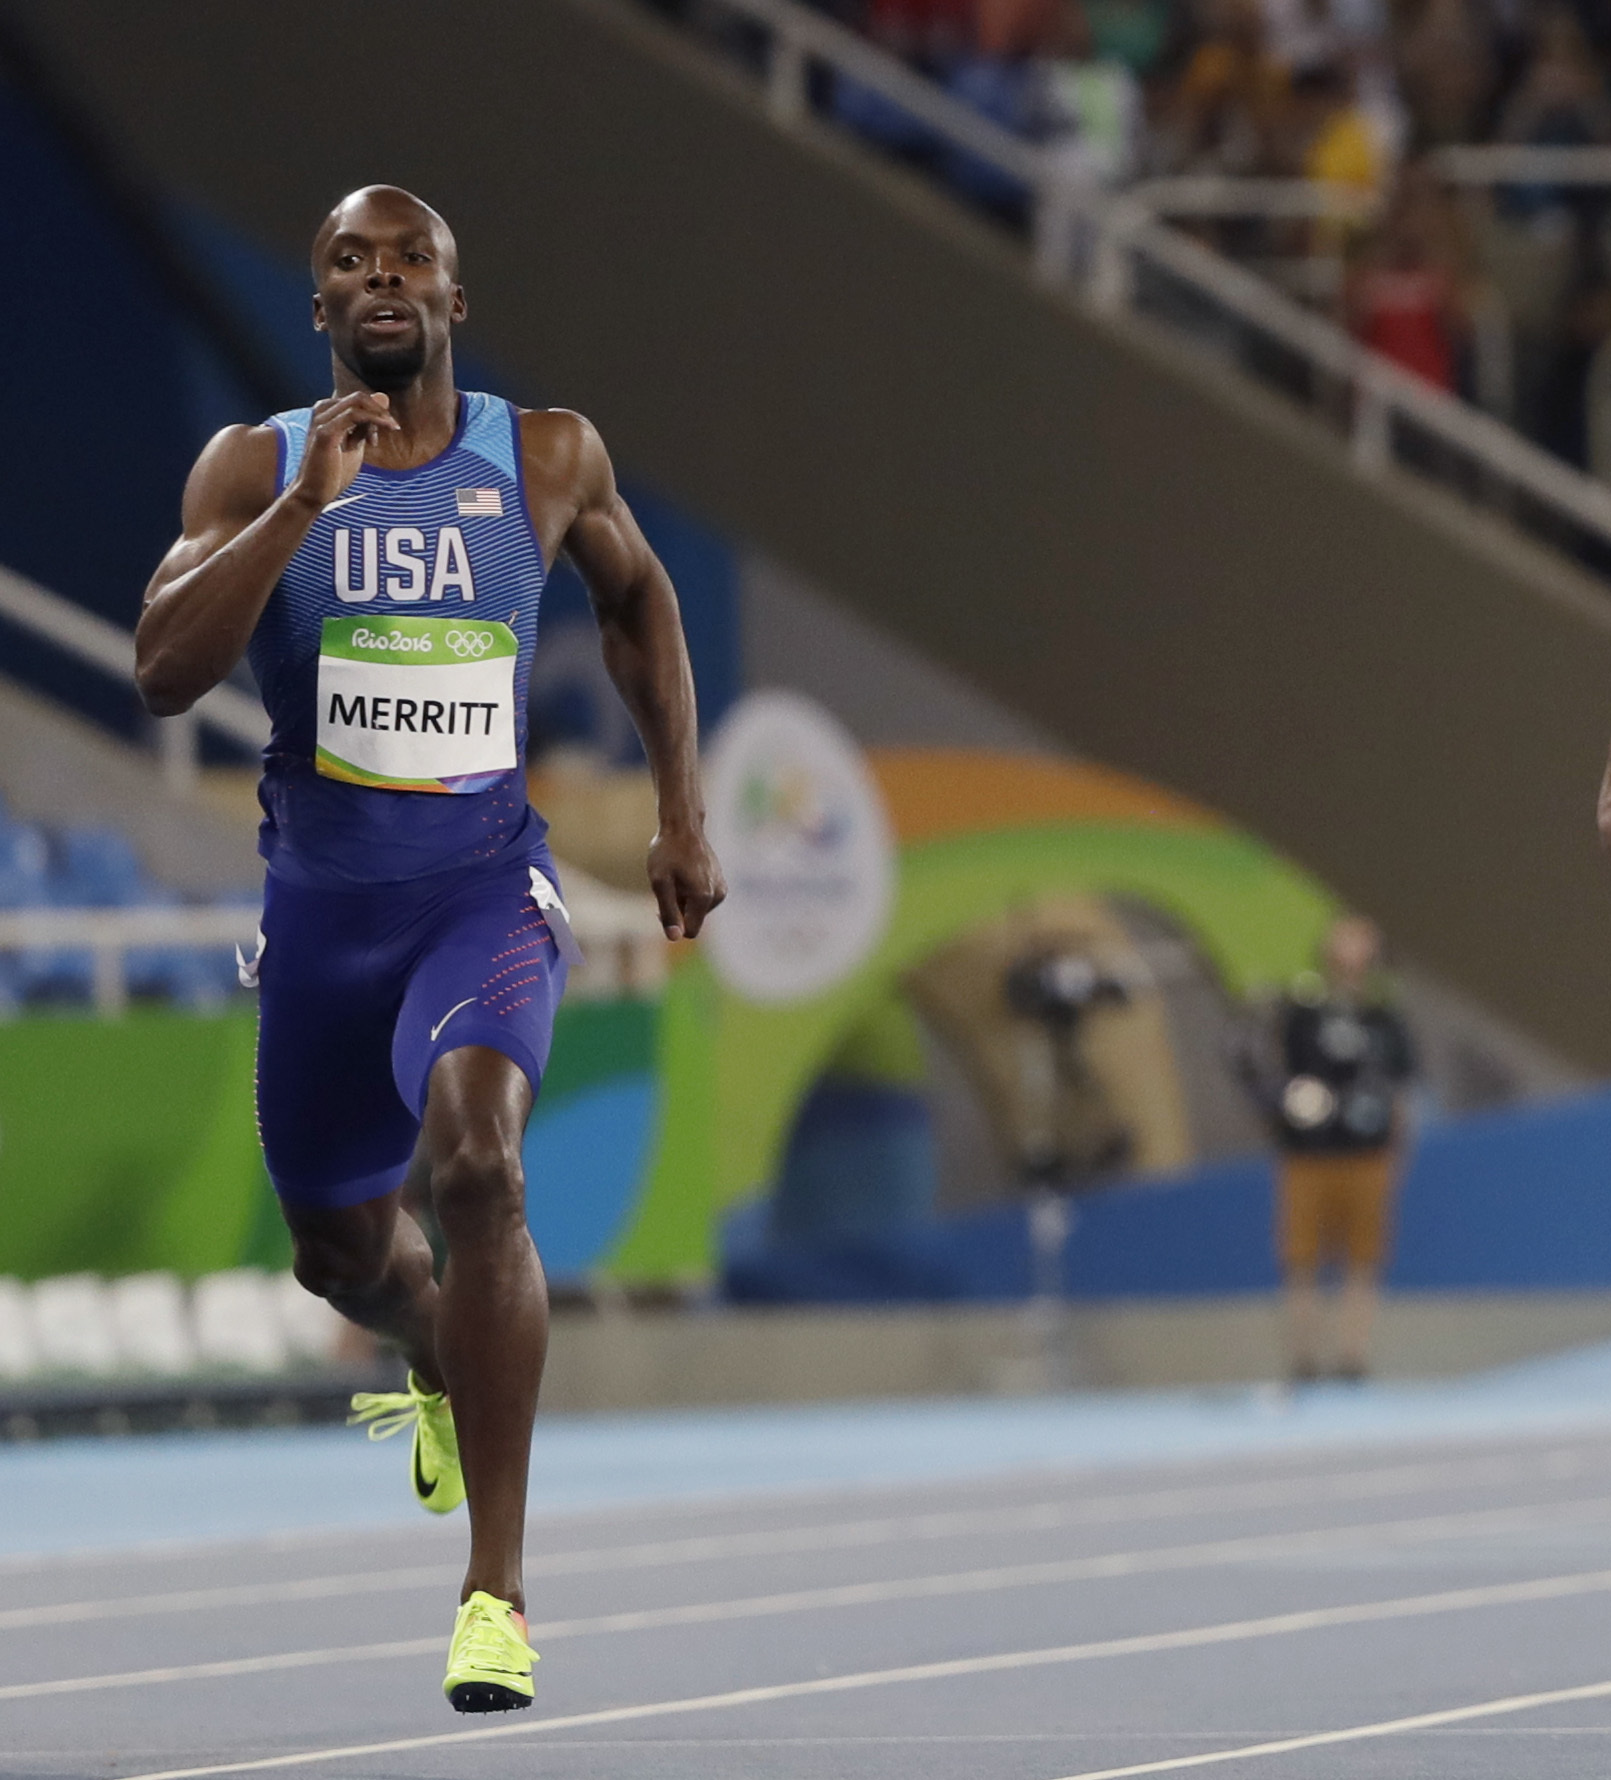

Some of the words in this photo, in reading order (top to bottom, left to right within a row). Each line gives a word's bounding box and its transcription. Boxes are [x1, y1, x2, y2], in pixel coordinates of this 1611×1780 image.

[334, 527, 475, 602] USA
[352, 628, 433, 652] Rio2016
[329, 693, 499, 735] MERRITT
